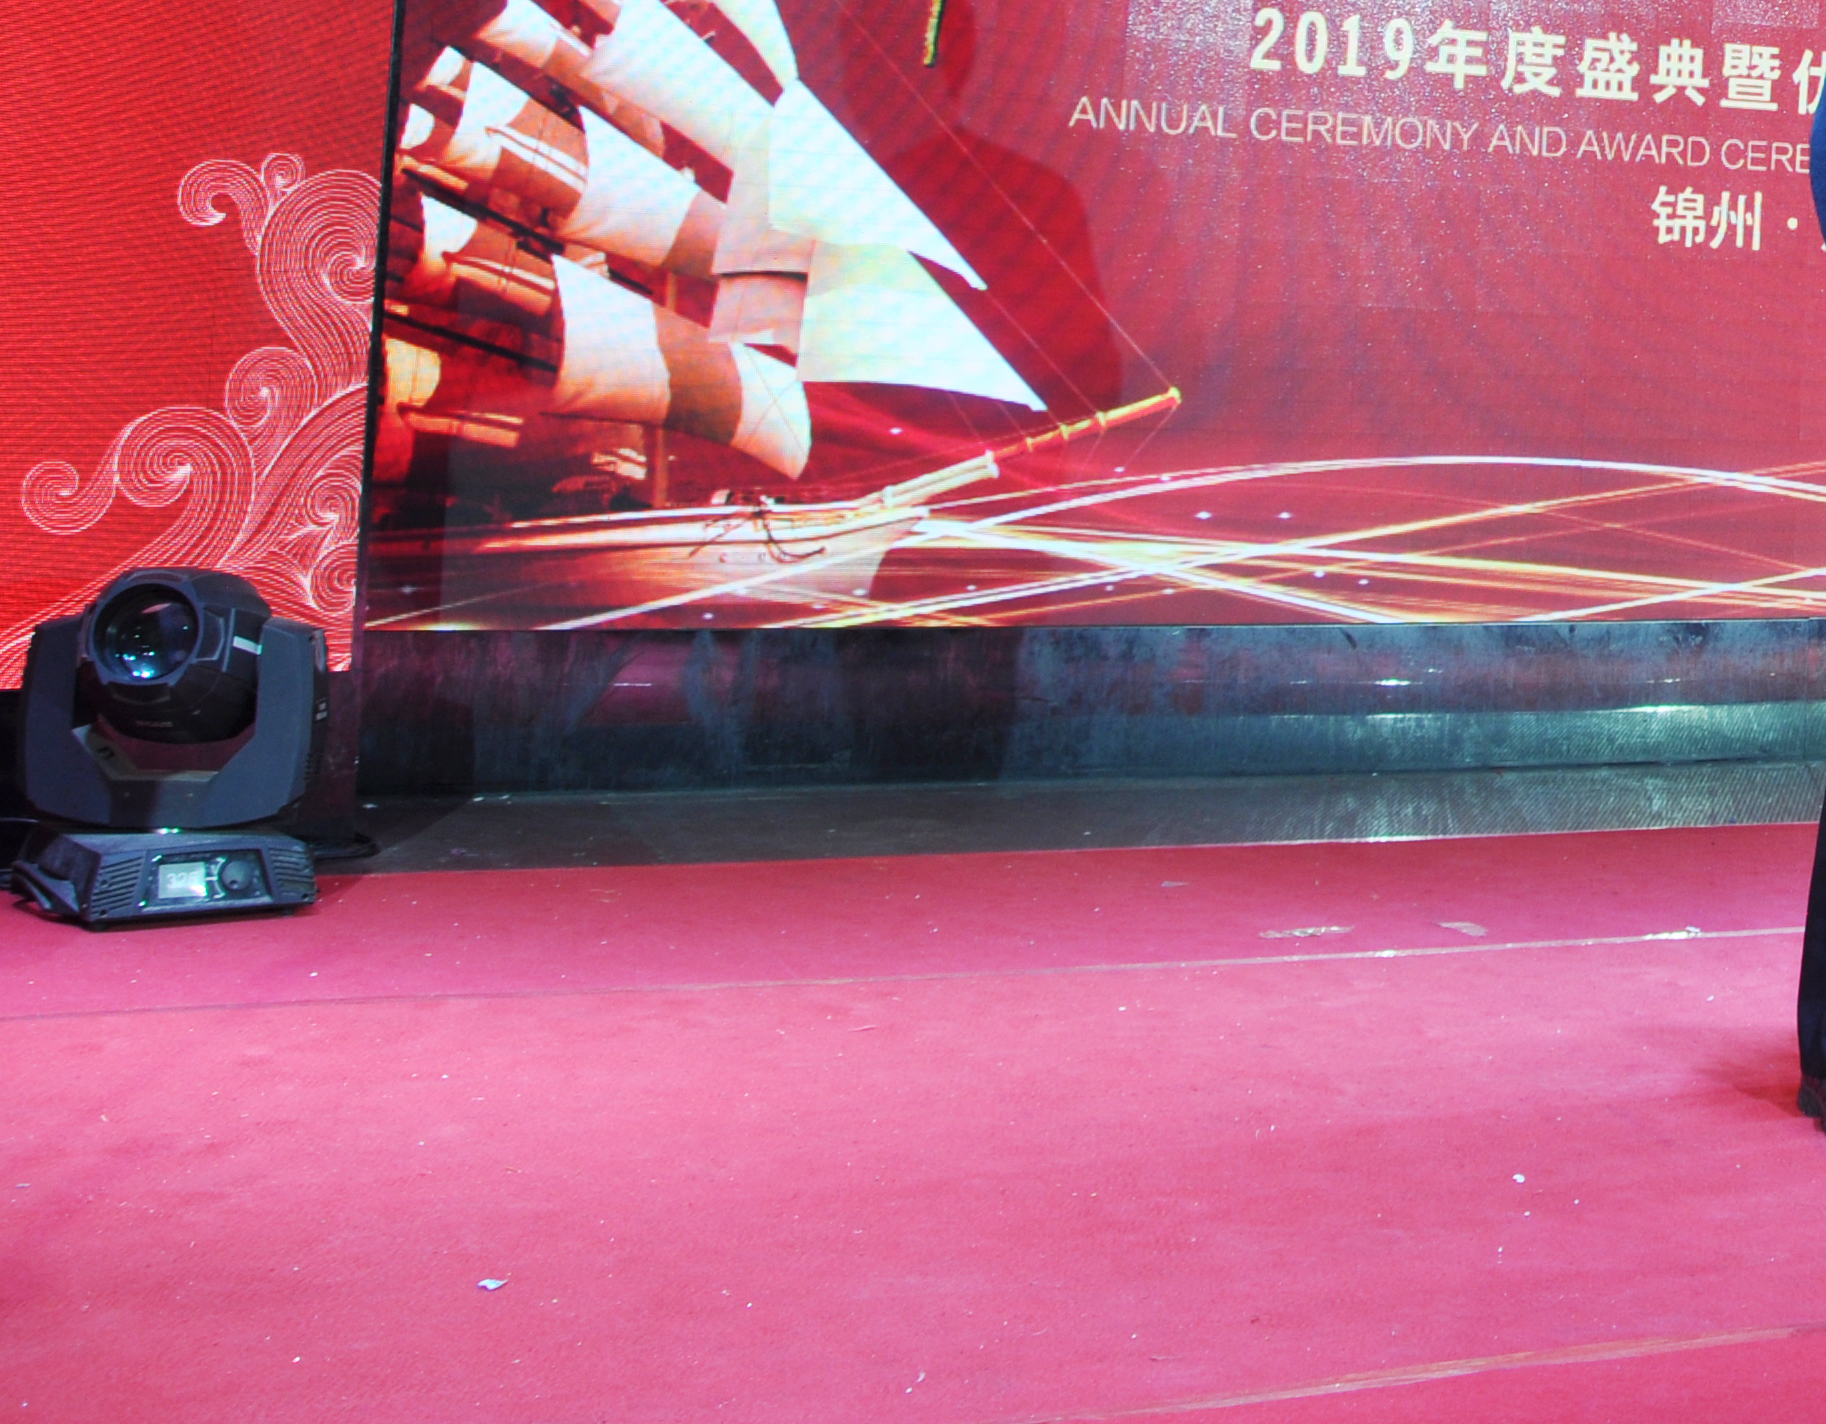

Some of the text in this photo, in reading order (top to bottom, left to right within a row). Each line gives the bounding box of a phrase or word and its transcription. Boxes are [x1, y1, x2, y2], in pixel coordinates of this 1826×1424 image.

[1069, 95, 1237, 139] ANNUAL
[1250, 107, 1479, 153] CEREMONY
[1488, 121, 1568, 158] AND
[1577, 131, 1711, 168] AWARD
